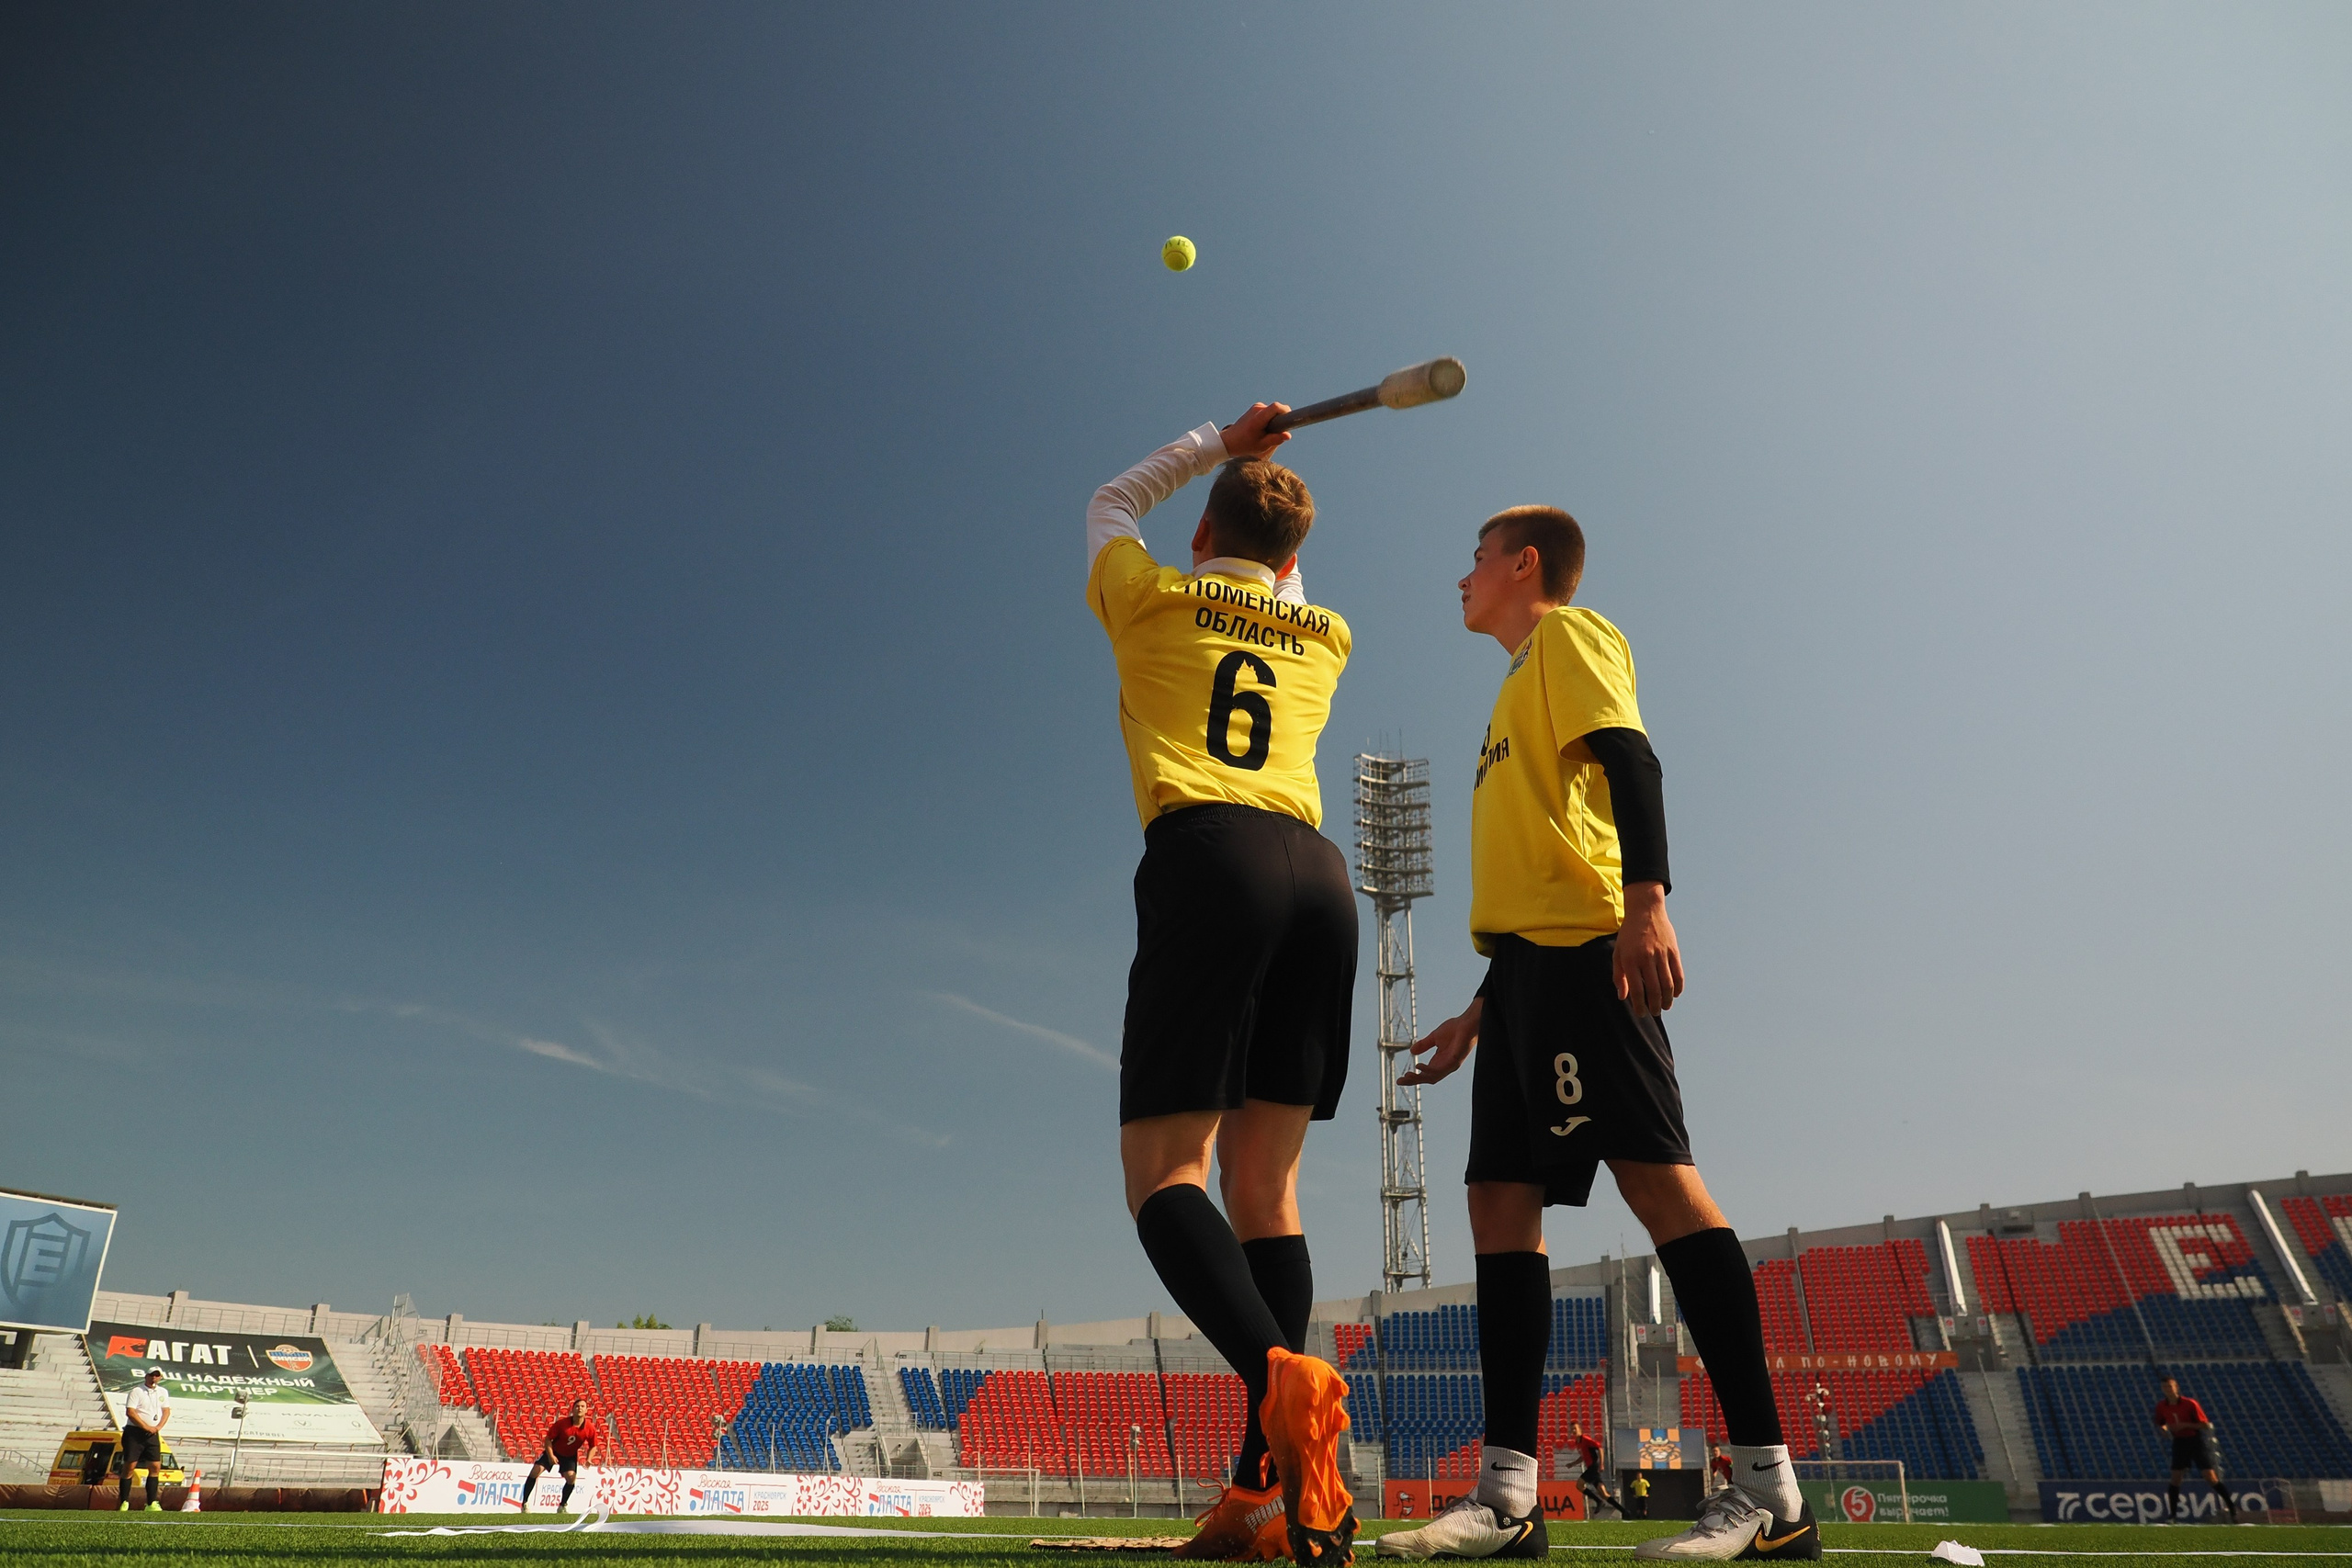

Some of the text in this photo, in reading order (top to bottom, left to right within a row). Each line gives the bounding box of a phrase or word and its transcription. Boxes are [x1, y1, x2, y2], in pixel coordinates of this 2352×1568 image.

[1195, 606, 1305, 656] ОБЛАСТЬ
[1206, 649, 1277, 772] 6
[1554, 1052, 1583, 1105] 8
[146, 1339, 232, 1365] АГАТ
[130, 1369, 182, 1381] ВШ
[180, 1383, 277, 1396] ПАРТНЕР
[567, 1435, 576, 1445] 9
[469, 1464, 514, 1481] Русская
[541, 1483, 585, 1494] КРАСНСК
[698, 1474, 731, 1488] Русская
[471, 1483, 526, 1506] ЛАПТ
[539, 1495, 561, 1506] 2025
[701, 1490, 744, 1511] ЛАПТА
[753, 1500, 769, 1511] 2025
[1851, 1488, 1867, 1517] 5
[1879, 1506, 1950, 1520] вырчает!
